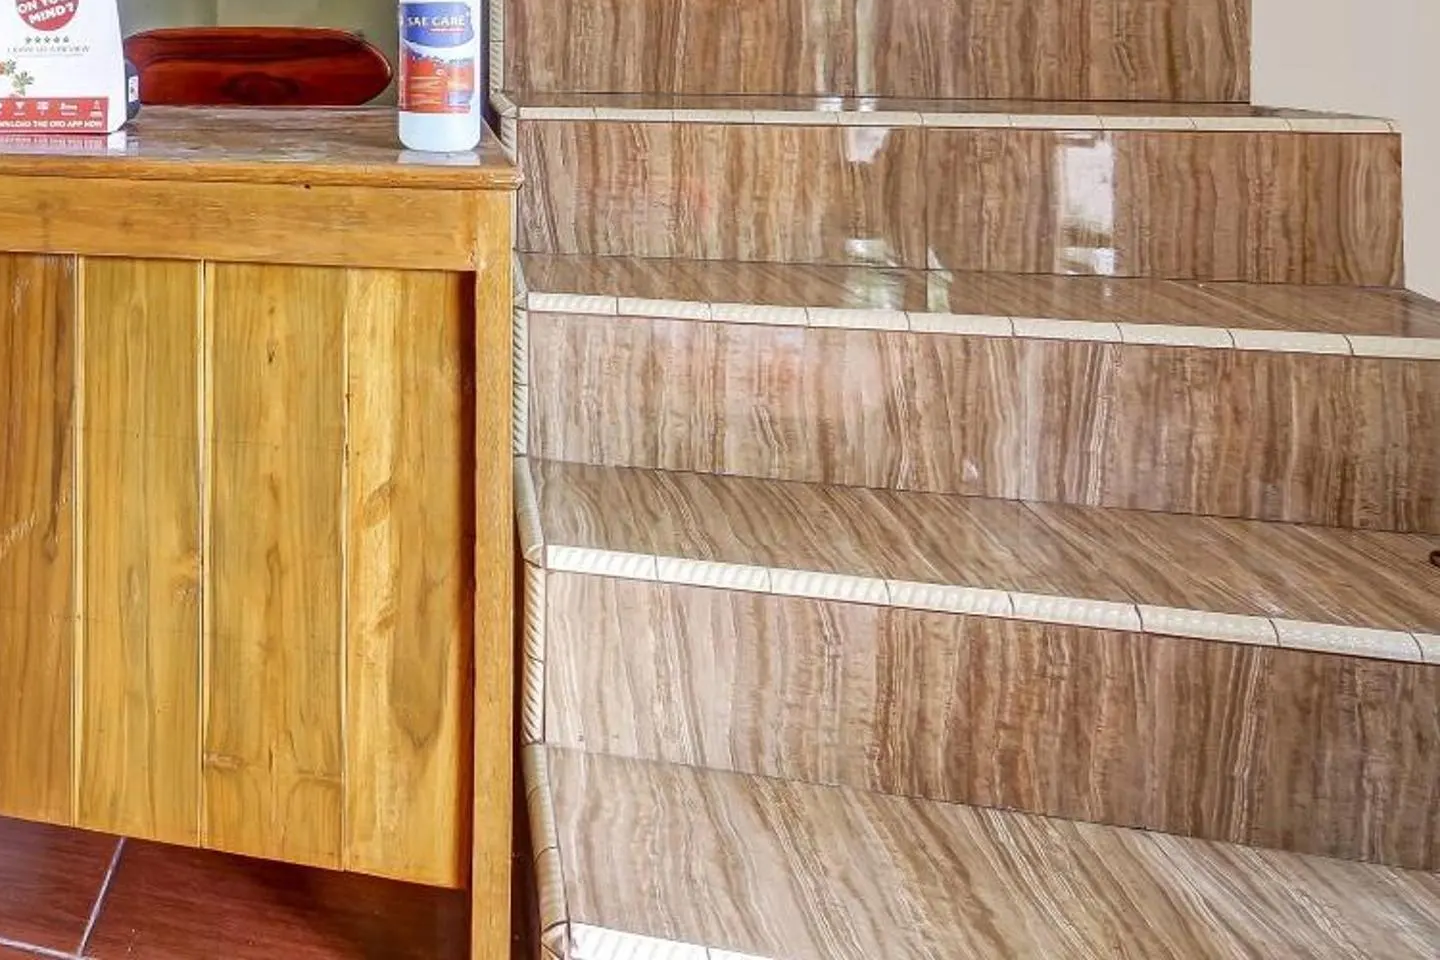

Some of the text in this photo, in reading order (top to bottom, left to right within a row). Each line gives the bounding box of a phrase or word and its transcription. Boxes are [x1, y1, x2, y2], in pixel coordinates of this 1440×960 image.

[18, 0, 38, 14] ON
[27, 2, 75, 24] MIND?
[431, 15, 465, 26] CARE
[33, 120, 49, 128] THE
[66, 120, 83, 128] APP
